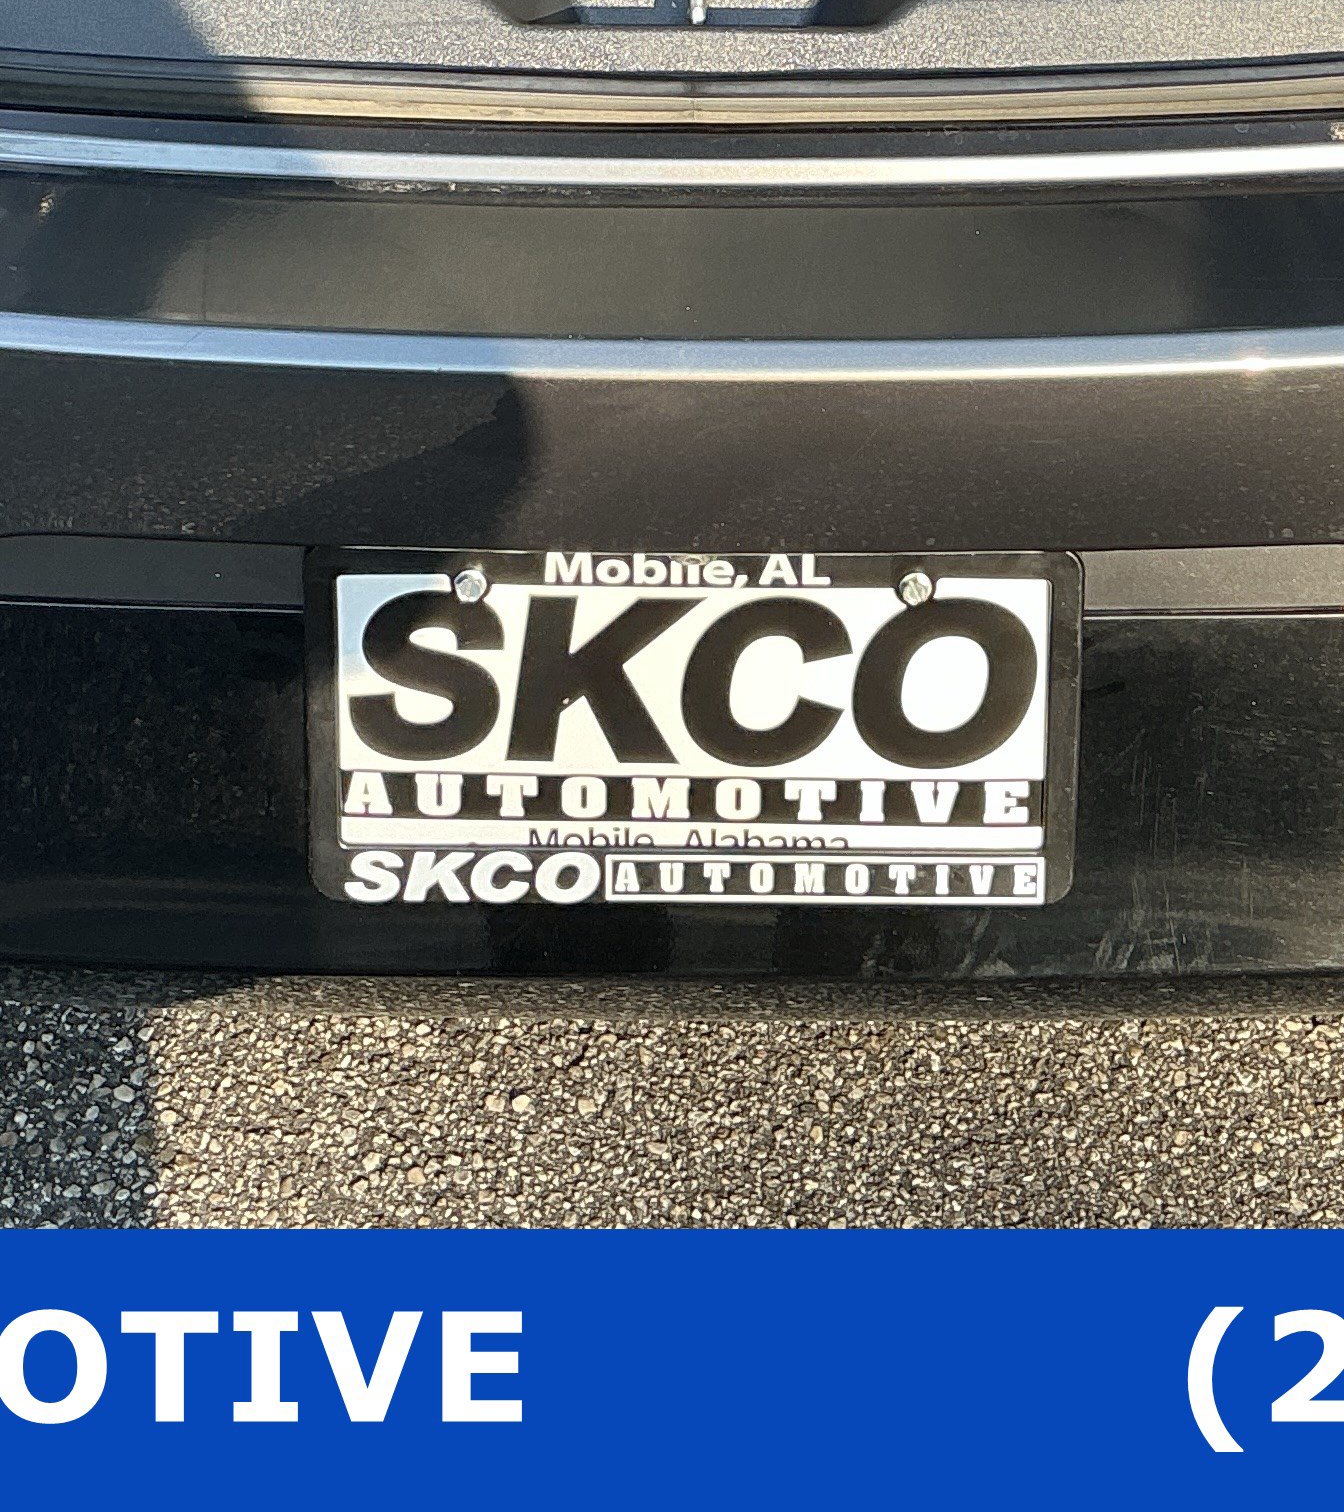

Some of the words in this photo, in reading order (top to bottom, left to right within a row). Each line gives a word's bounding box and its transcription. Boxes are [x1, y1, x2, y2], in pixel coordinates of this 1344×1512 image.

[544, 551, 748, 589] Mobile,
[758, 553, 832, 586] AL
[347, 589, 1039, 770] SKCO
[344, 772, 1031, 826] AUTOMOTIVE
[344, 850, 602, 904] SKCO
[614, 861, 1039, 897] AUTOMOTIVE
